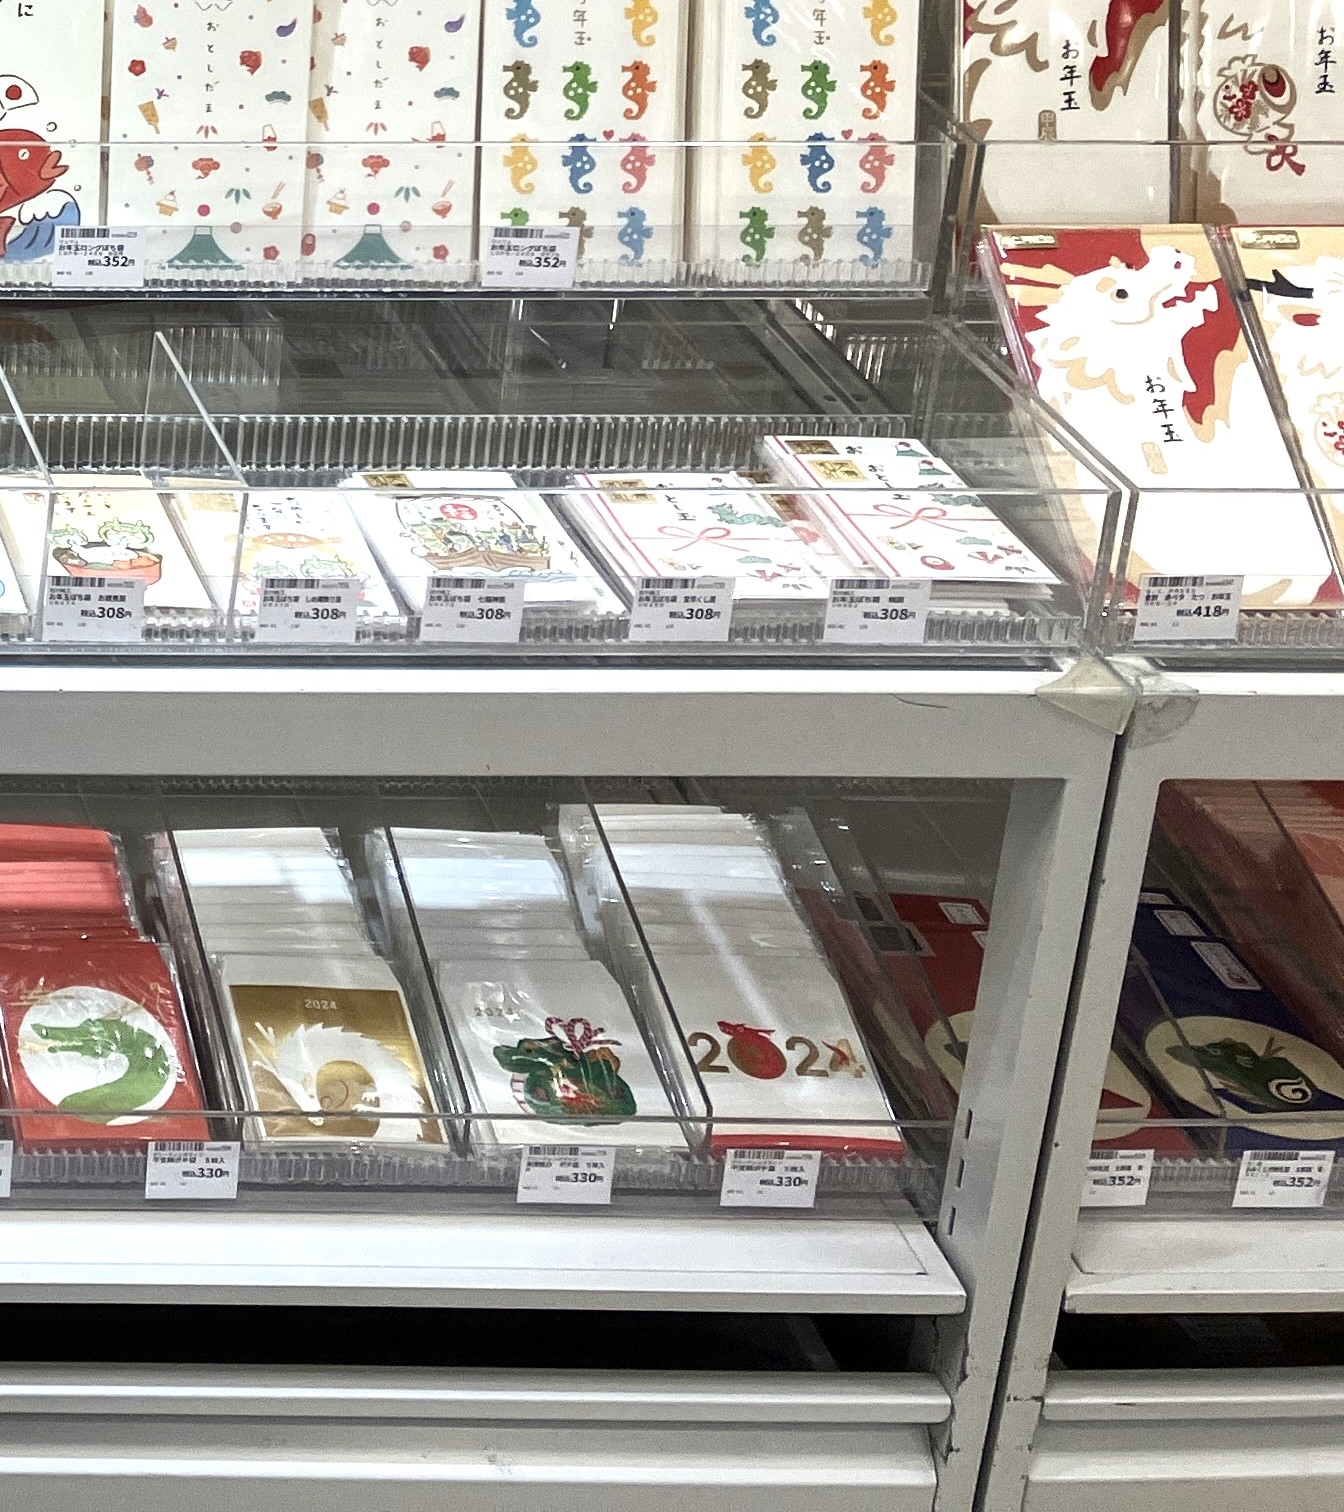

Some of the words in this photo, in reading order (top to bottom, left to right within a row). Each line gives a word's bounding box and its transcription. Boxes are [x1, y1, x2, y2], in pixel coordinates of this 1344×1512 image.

[203, 19, 223, 117] おとしだま
[1059, 37, 1082, 113] お年玉
[1314, 25, 1337, 95] お年玉
[519, 257, 566, 268] 税込352円
[1142, 374, 1185, 446] お年玉
[295, 608, 346, 620] 税込308円
[1176, 605, 1224, 617] 税込418円
[305, 998, 338, 1010] 2024
